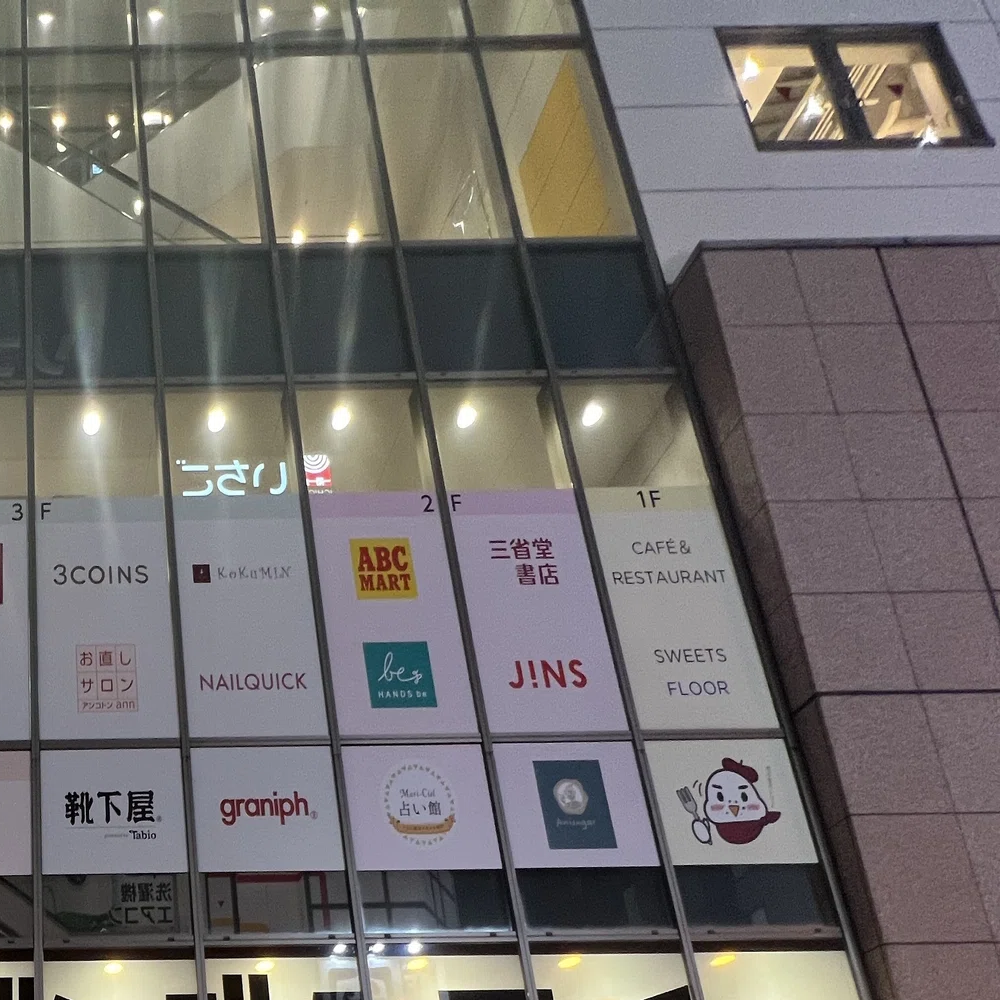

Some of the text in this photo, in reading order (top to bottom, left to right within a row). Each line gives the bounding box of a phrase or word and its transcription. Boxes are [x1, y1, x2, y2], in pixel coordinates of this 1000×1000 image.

[637, 490, 661, 508] 1F
[489, 537, 555, 560] 三省堂
[357, 545, 408, 572] ABC
[53, 564, 149, 585] 3COINS
[358, 573, 411, 592] MART
[515, 563, 560, 586] 書店
[612, 569, 726, 585] RESTAURANT
[80, 651, 132, 667] お直し
[653, 648, 728, 663] SWEETS
[81, 678, 134, 693] サロン
[200, 672, 307, 691] NAILQUICK
[667, 680, 730, 696] FLOOR
[378, 690, 413, 698] HANDS
[116, 700, 135, 709] ann
[64, 790, 155, 826] 靴下屋
[219, 791, 310, 826] graniph
[399, 801, 442, 817] 占い館
[128, 830, 157, 840] Tabio
